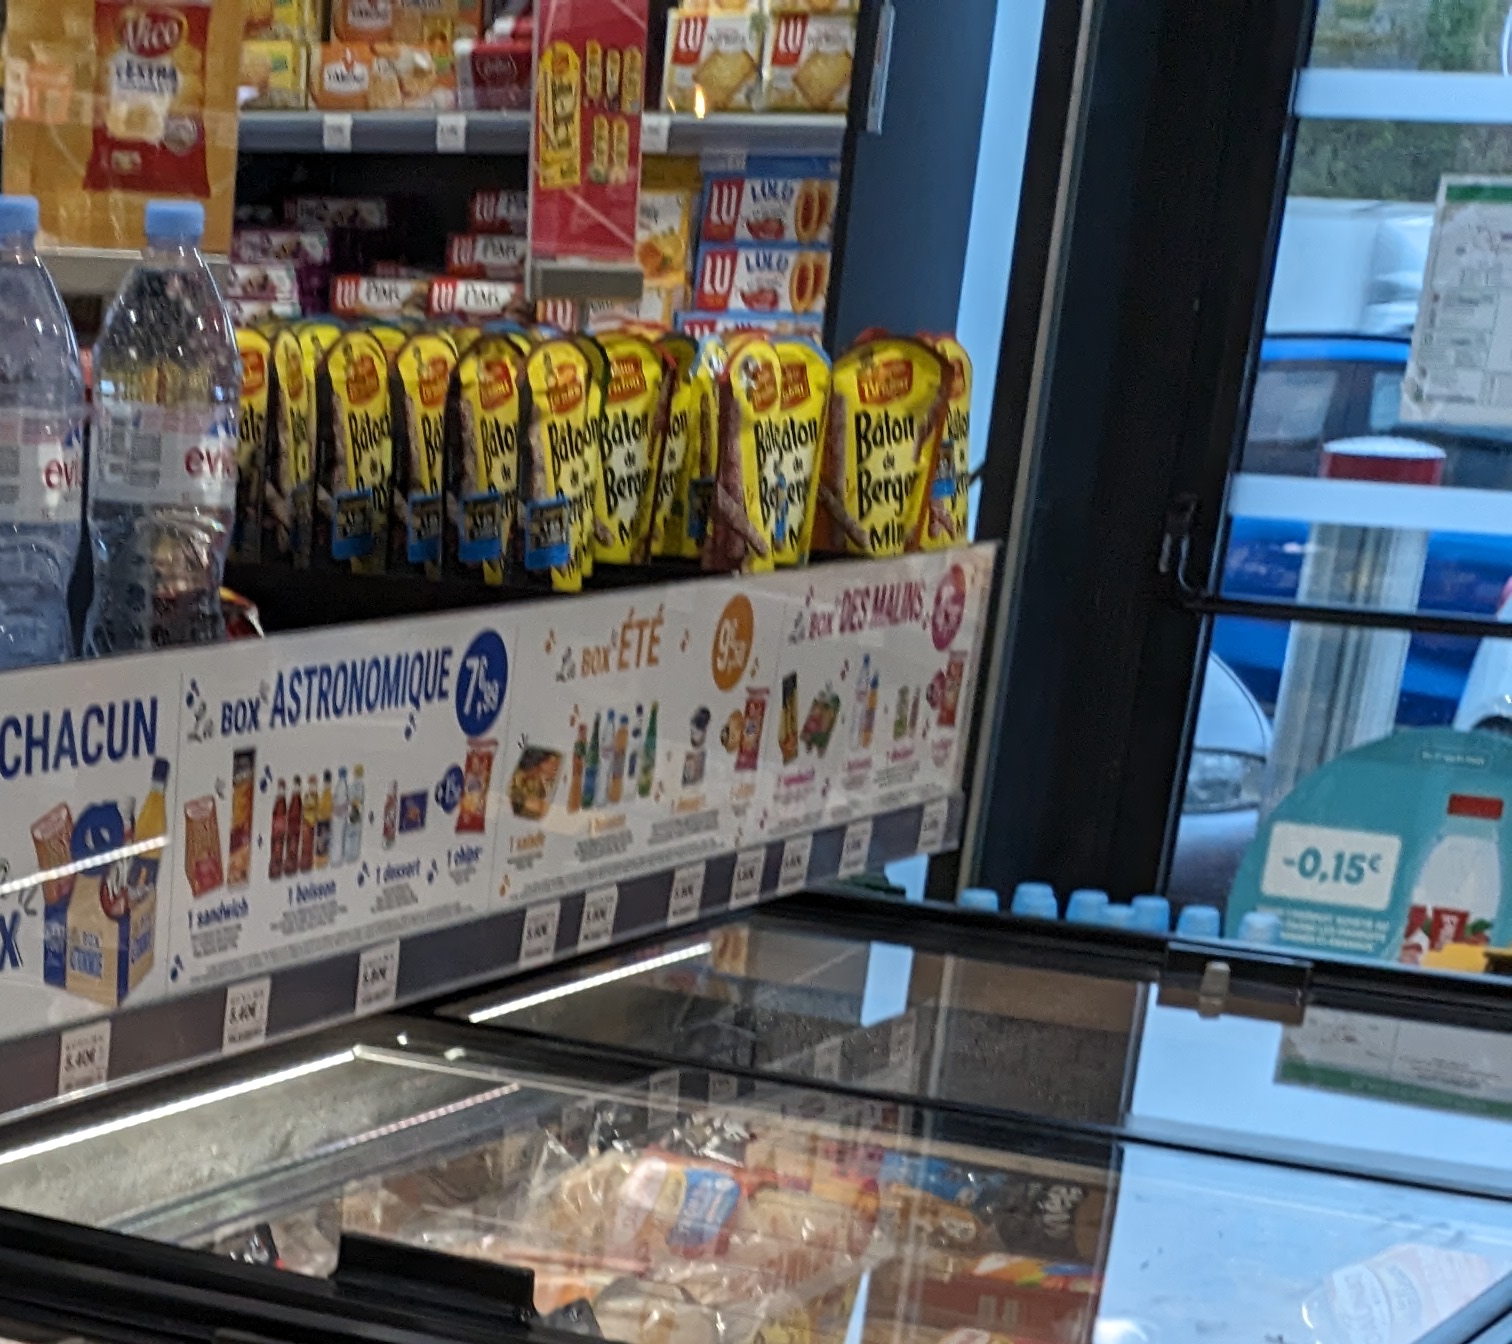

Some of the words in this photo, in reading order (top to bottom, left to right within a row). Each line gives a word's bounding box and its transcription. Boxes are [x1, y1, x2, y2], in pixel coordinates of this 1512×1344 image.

[580, 641, 614, 677] BOX
[617, 603, 665, 670] ÉTÉ
[838, 586, 870, 633] DES
[221, 698, 262, 737] BOX
[269, 647, 453, 730] ASTRONOMIQUE
